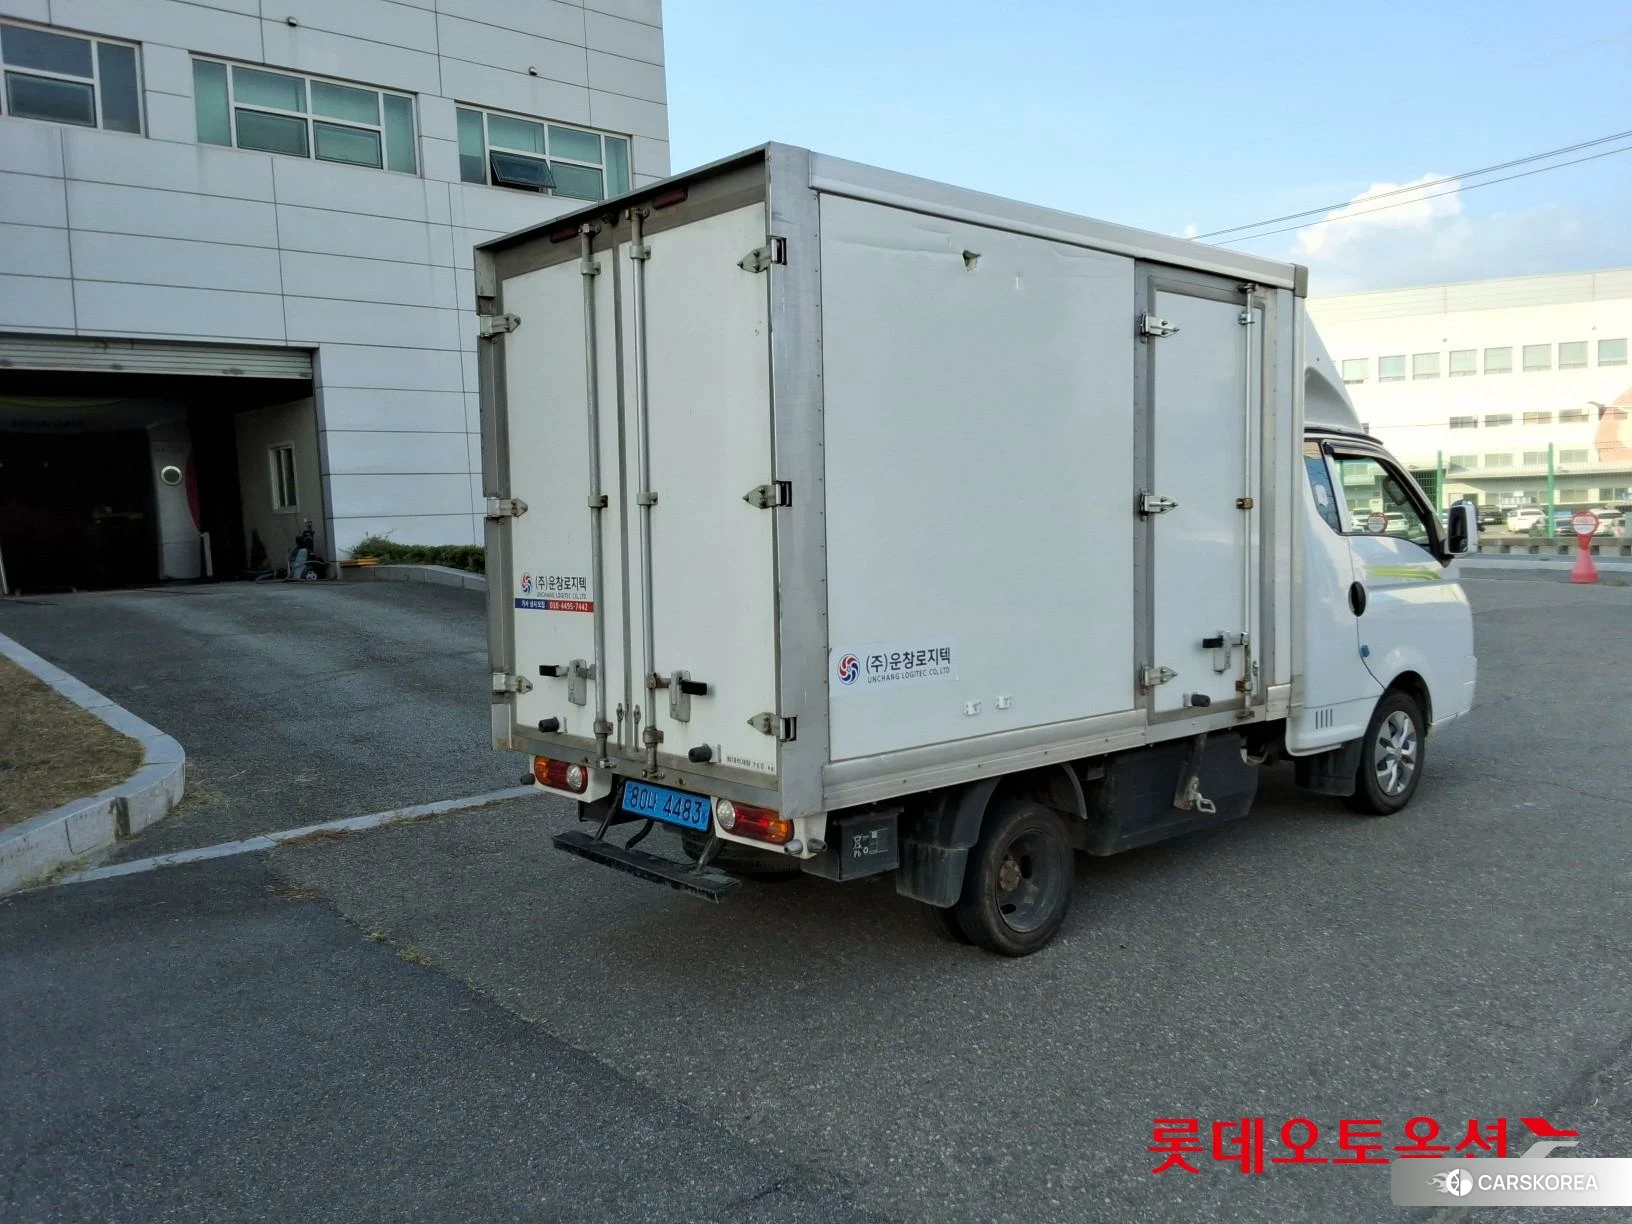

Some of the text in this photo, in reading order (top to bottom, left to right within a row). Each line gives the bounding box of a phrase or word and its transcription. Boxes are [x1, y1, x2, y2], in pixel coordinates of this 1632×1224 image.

[535, 575, 587, 591] (주)운창로지텍
[866, 647, 950, 674] (주)운창로지텍
[867, 673, 900, 684] UNCHANG
[901, 669, 927, 680] LOGITEC
[663, 794, 703, 825] 4483
